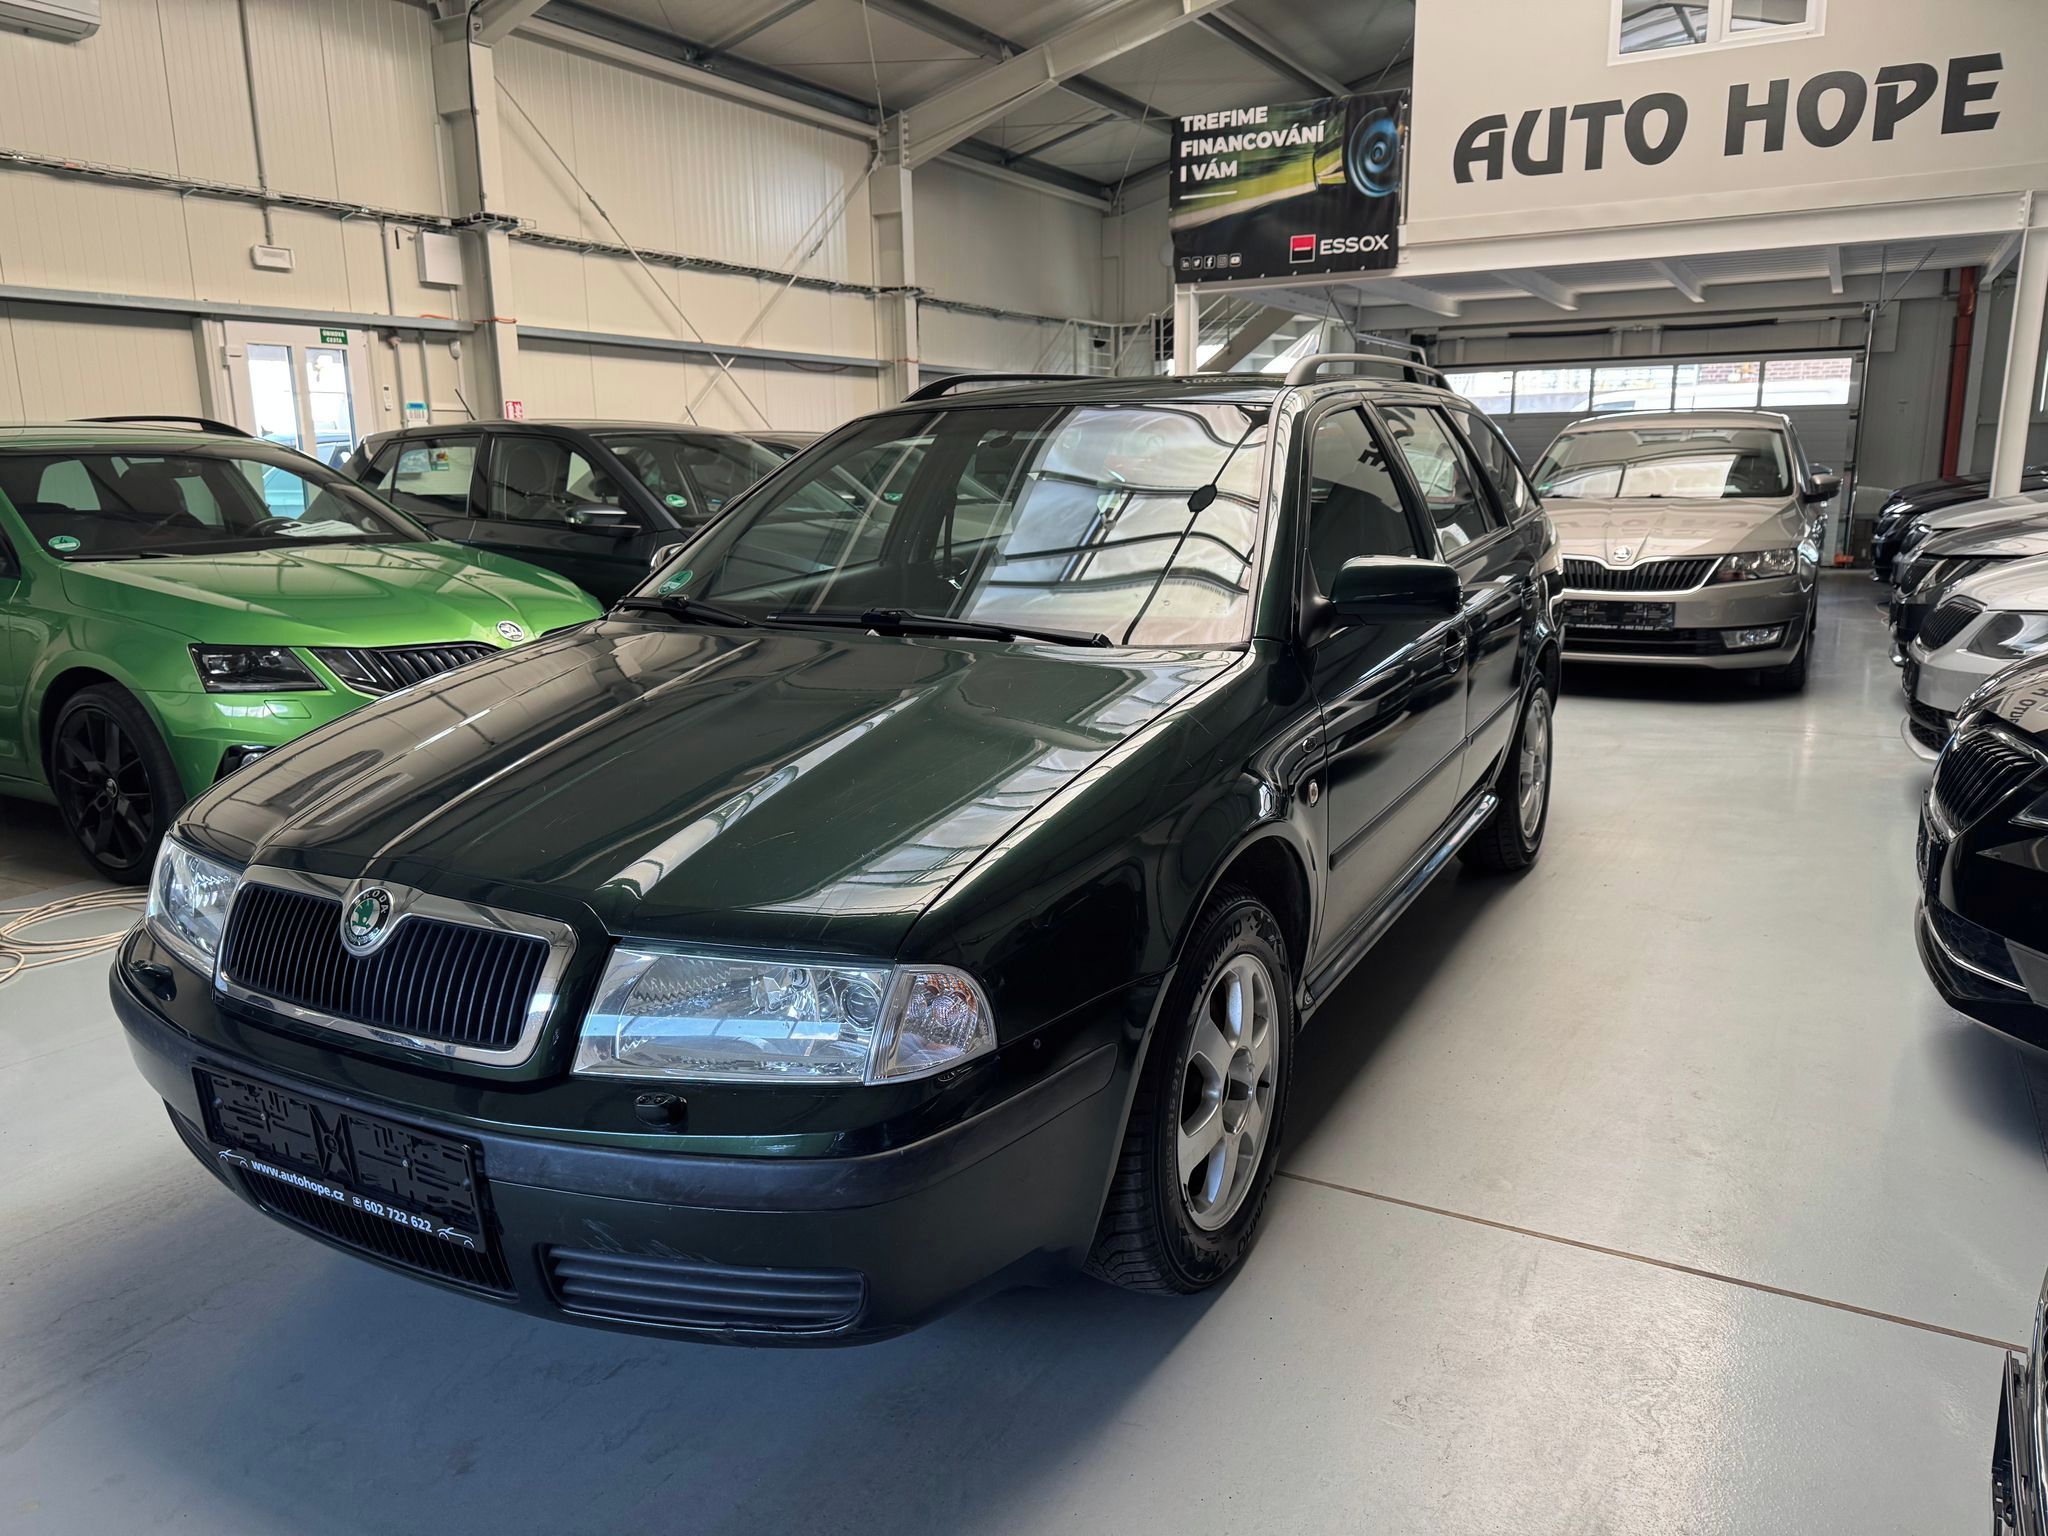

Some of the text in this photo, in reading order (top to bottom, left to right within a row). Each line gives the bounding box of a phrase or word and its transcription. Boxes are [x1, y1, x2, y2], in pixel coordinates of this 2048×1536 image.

[1180, 106, 1269, 133] TREFIME
[1453, 52, 2004, 184] AUTO HOPE
[1180, 120, 1327, 158] FINANCOVÁNÍ
[1179, 160, 1238, 183] I VÁM
[1319, 234, 1390, 256] ESSOX
[1200, 918, 1242, 994] KUMHO
[250, 1159, 433, 1233] www.autohope.cz 602 722 622
